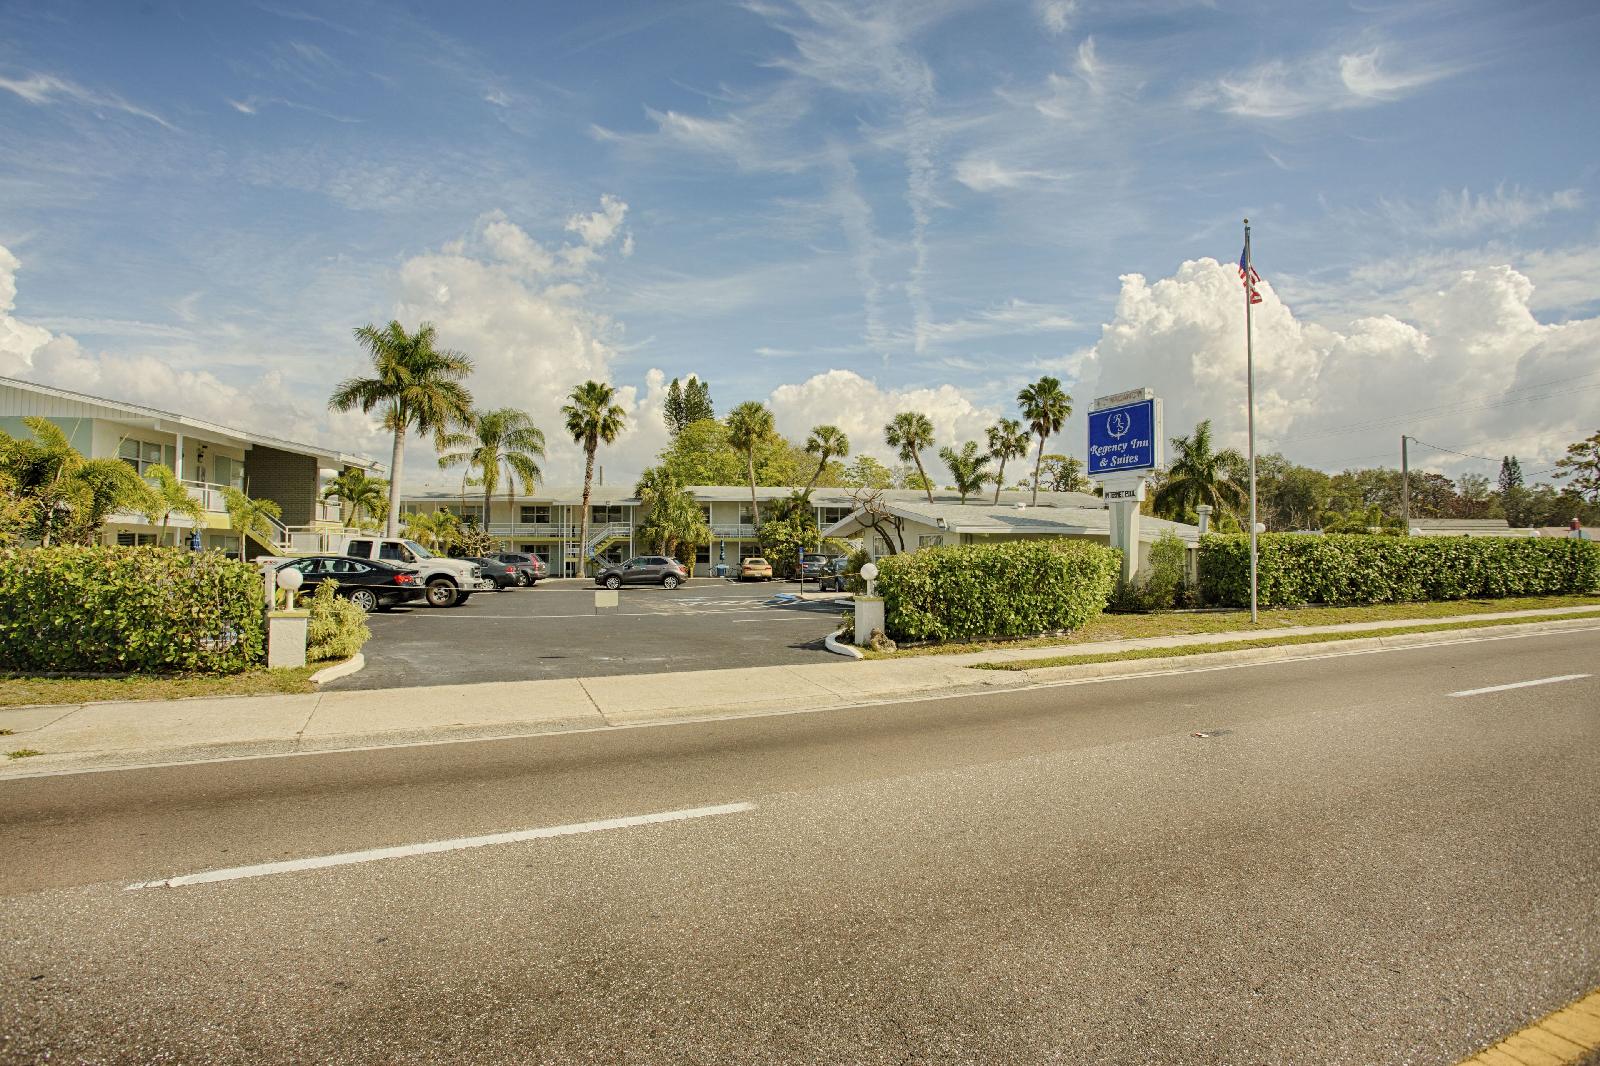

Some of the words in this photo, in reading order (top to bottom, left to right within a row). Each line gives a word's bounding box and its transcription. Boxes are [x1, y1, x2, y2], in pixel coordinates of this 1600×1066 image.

[1090, 442, 1128, 456] Regency
[1131, 439, 1149, 449] Inn
[1100, 457, 1108, 467] &
[1110, 454, 1139, 466] Suites
